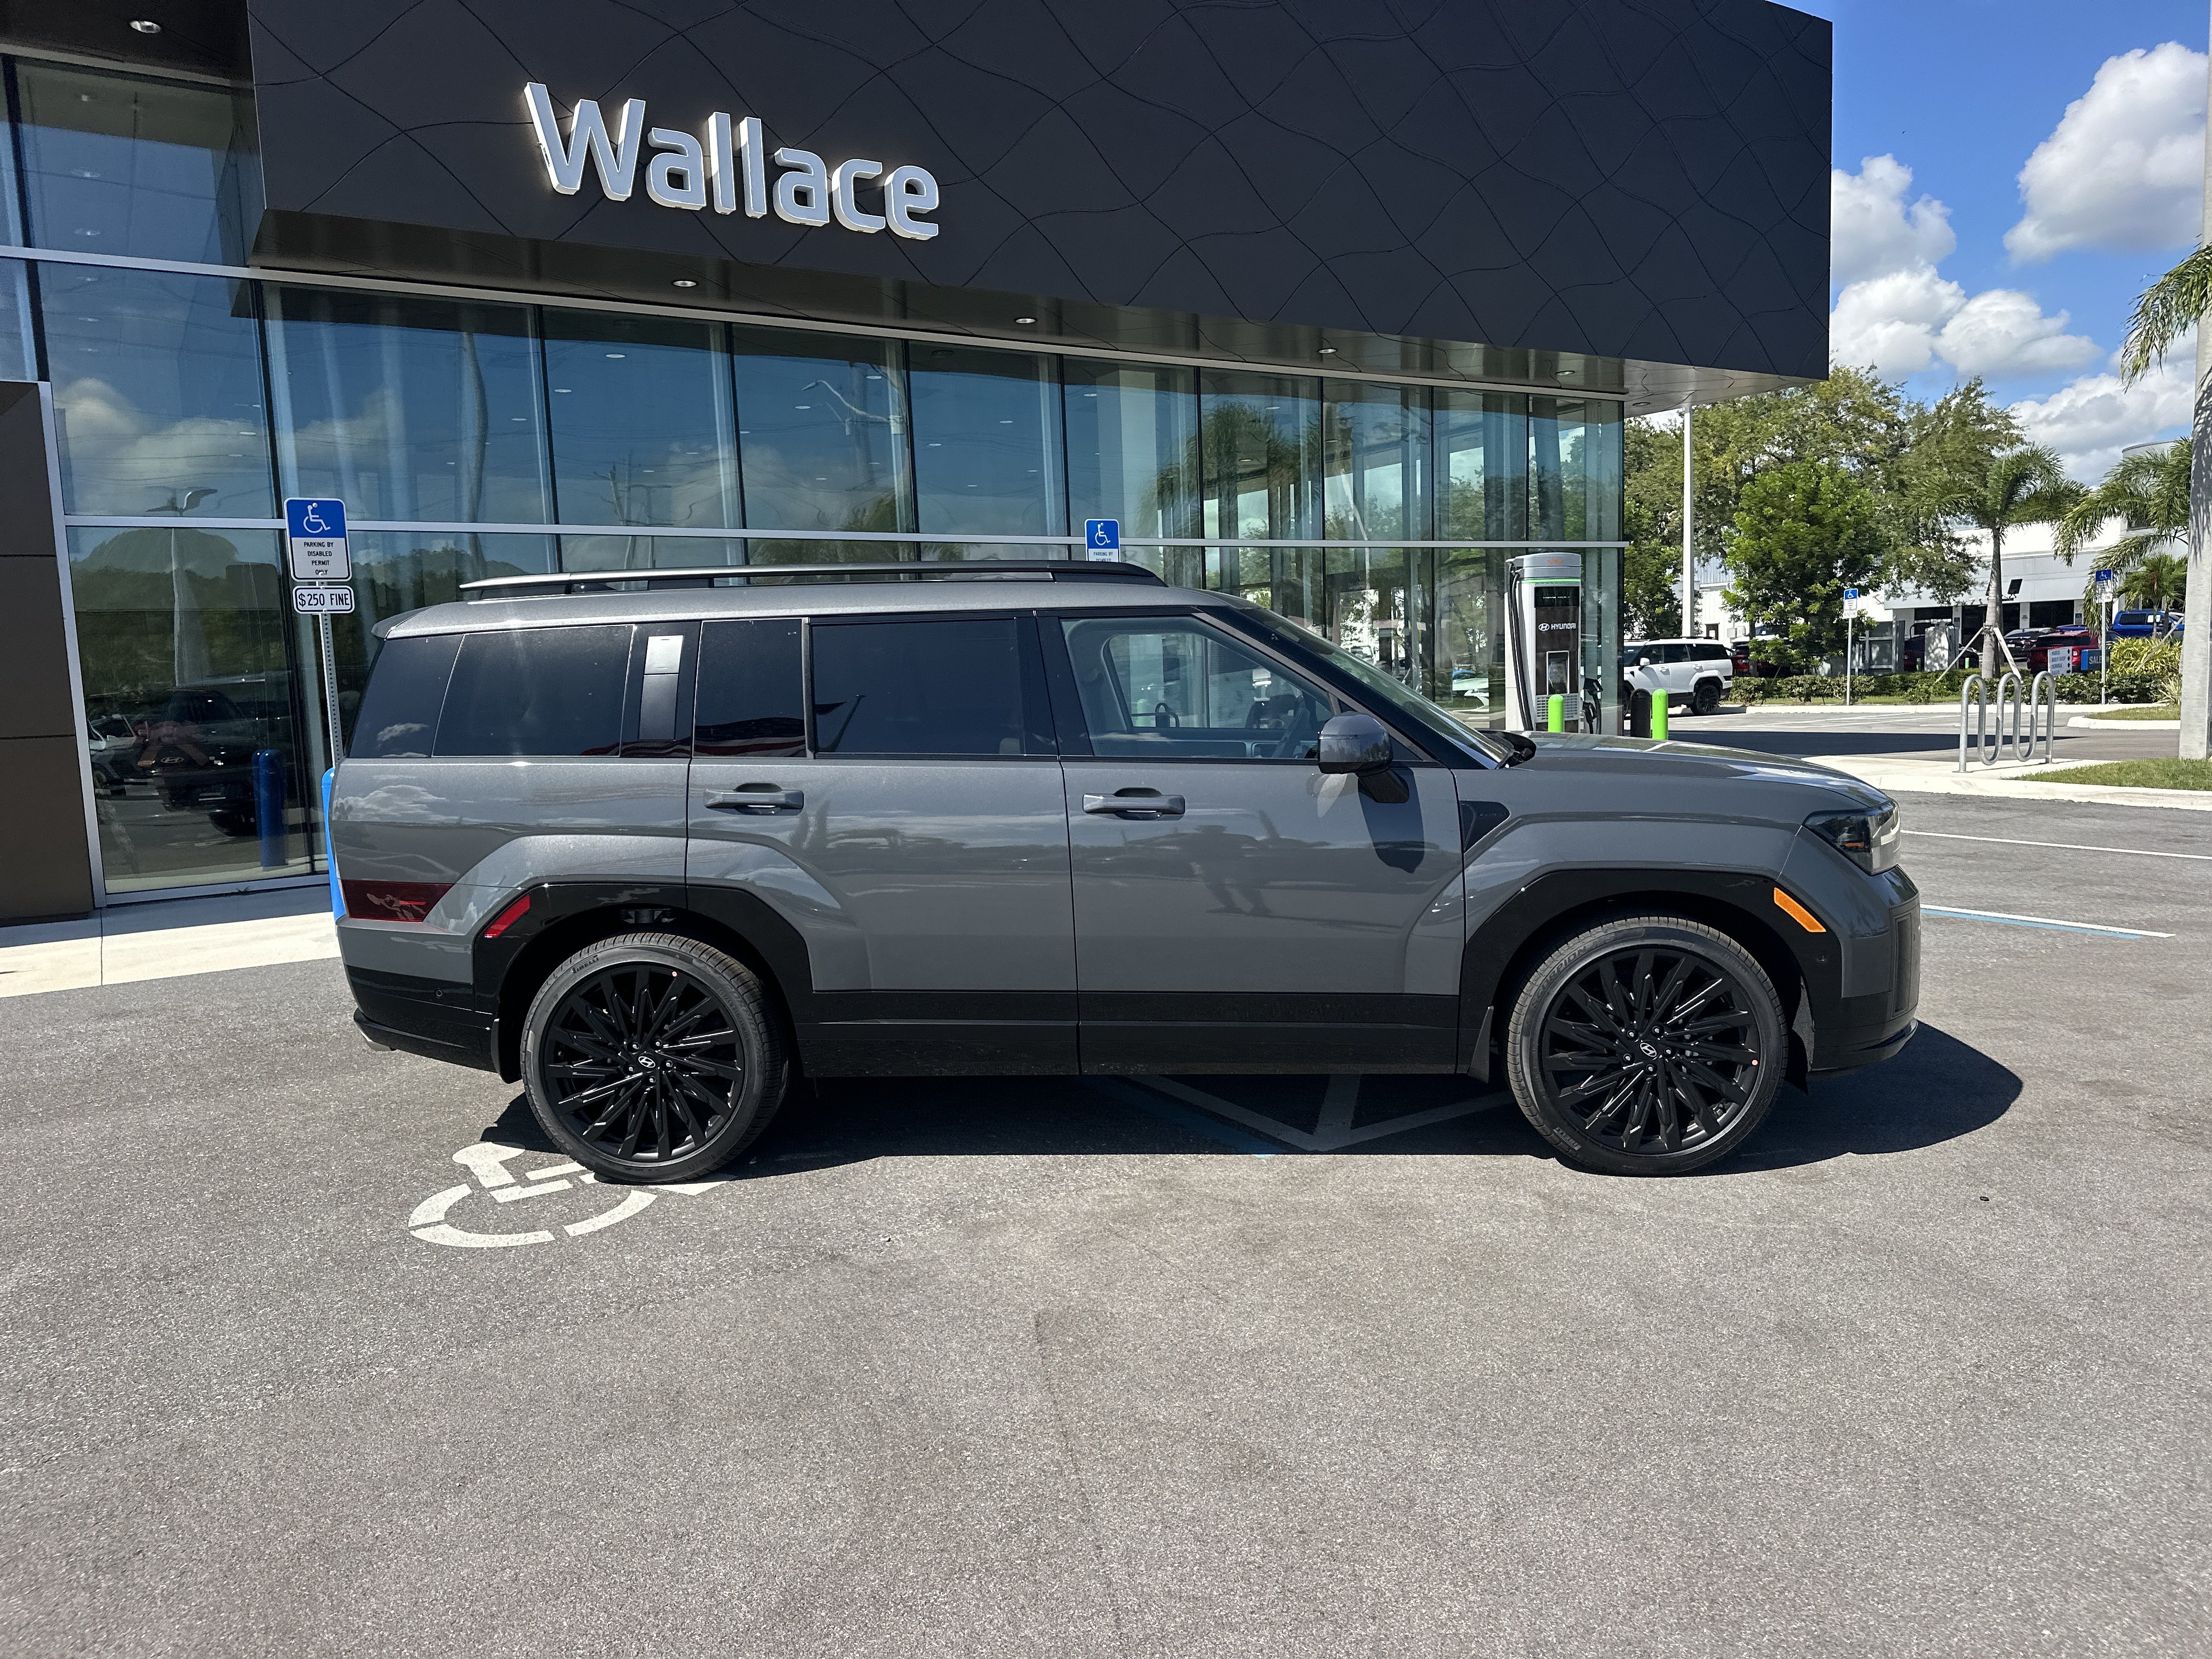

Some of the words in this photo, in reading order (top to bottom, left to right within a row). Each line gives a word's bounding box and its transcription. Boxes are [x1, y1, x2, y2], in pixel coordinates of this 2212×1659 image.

[523, 82, 939, 241] Wallace
[298, 592, 325, 607] $250
[330, 593, 350, 606] FINE
[2089, 655, 2105, 664] SALE
[572, 954, 599, 974] PIRELLI
[1532, 945, 1588, 1009] SCORPION
[1553, 1126, 1582, 1151] PIRELLI
